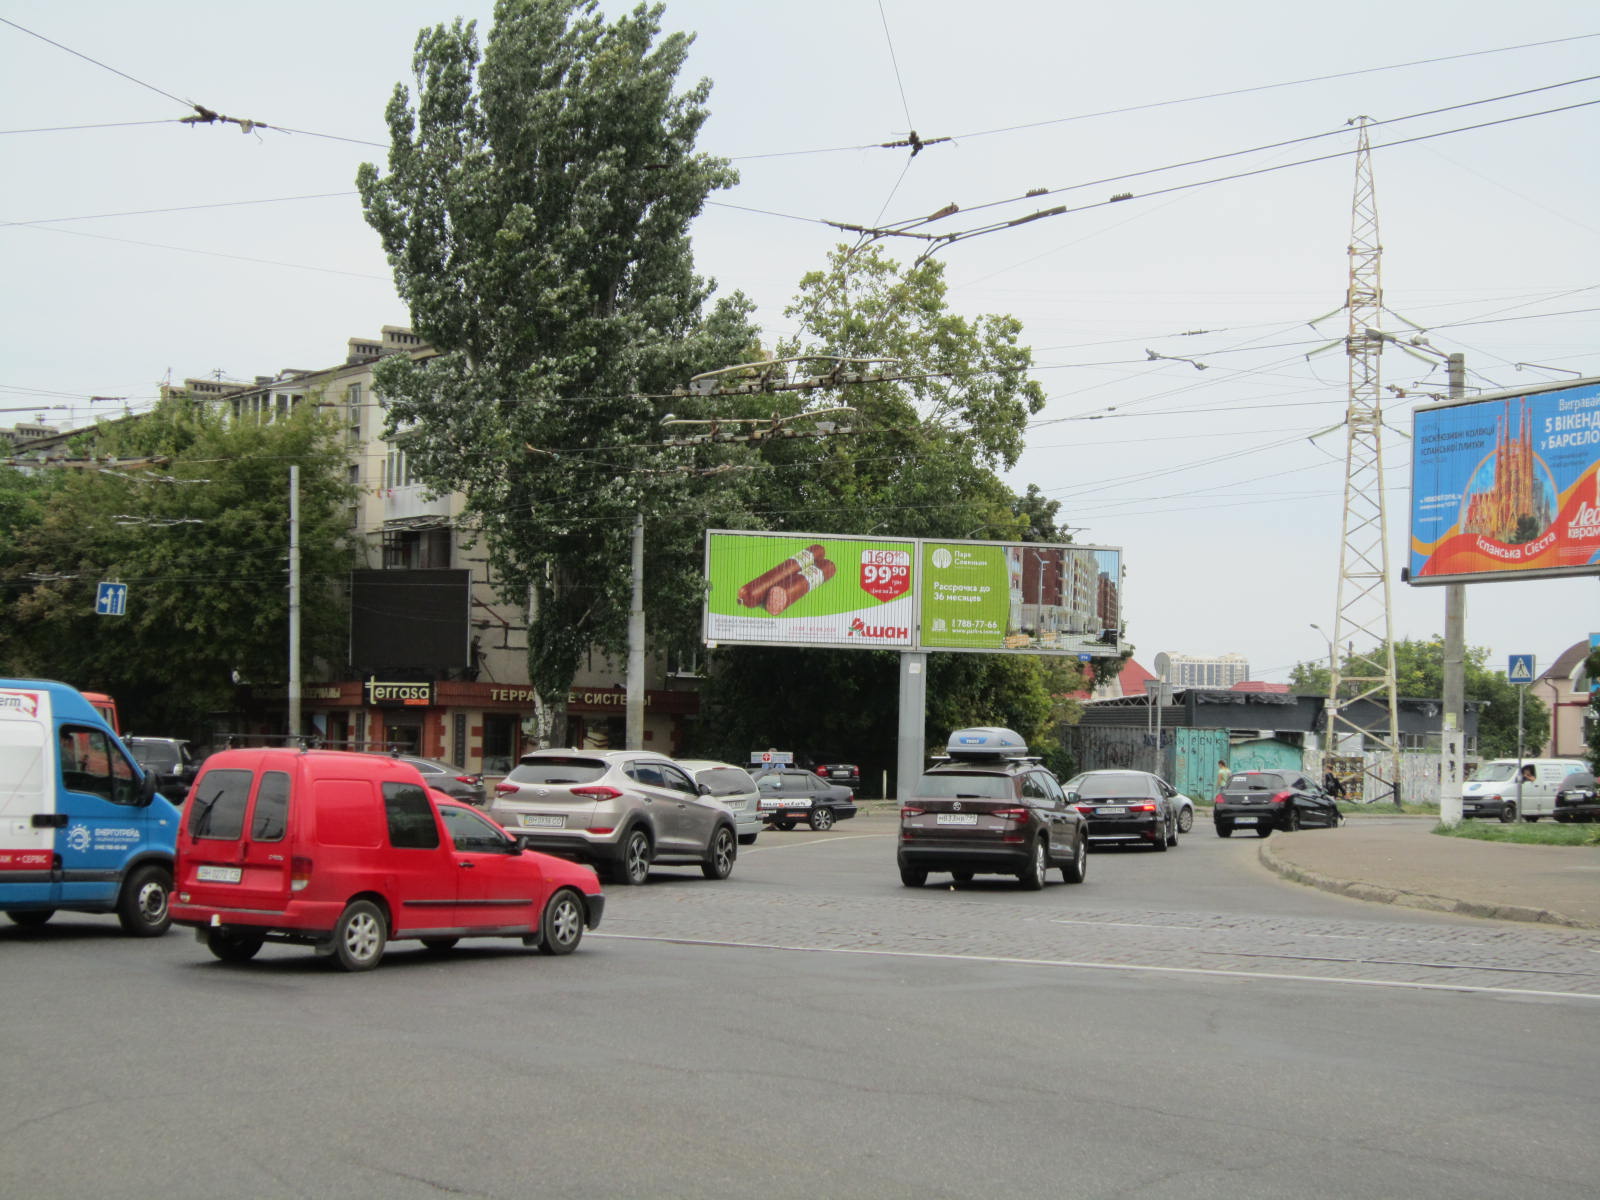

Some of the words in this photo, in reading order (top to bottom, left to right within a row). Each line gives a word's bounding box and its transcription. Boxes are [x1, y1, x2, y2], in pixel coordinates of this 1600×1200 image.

[1545, 417, 1552, 433] 5
[1476, 535, 1521, 559] Іспанська
[1524, 532, 1556, 556] Сієста
[864, 566, 892, 584] 99
[933, 582, 978, 593] Рассрочка
[933, 592, 944, 601] 36
[364, 675, 430, 705] terrasa
[584, 692, 651, 706] СИСТЕЫ
